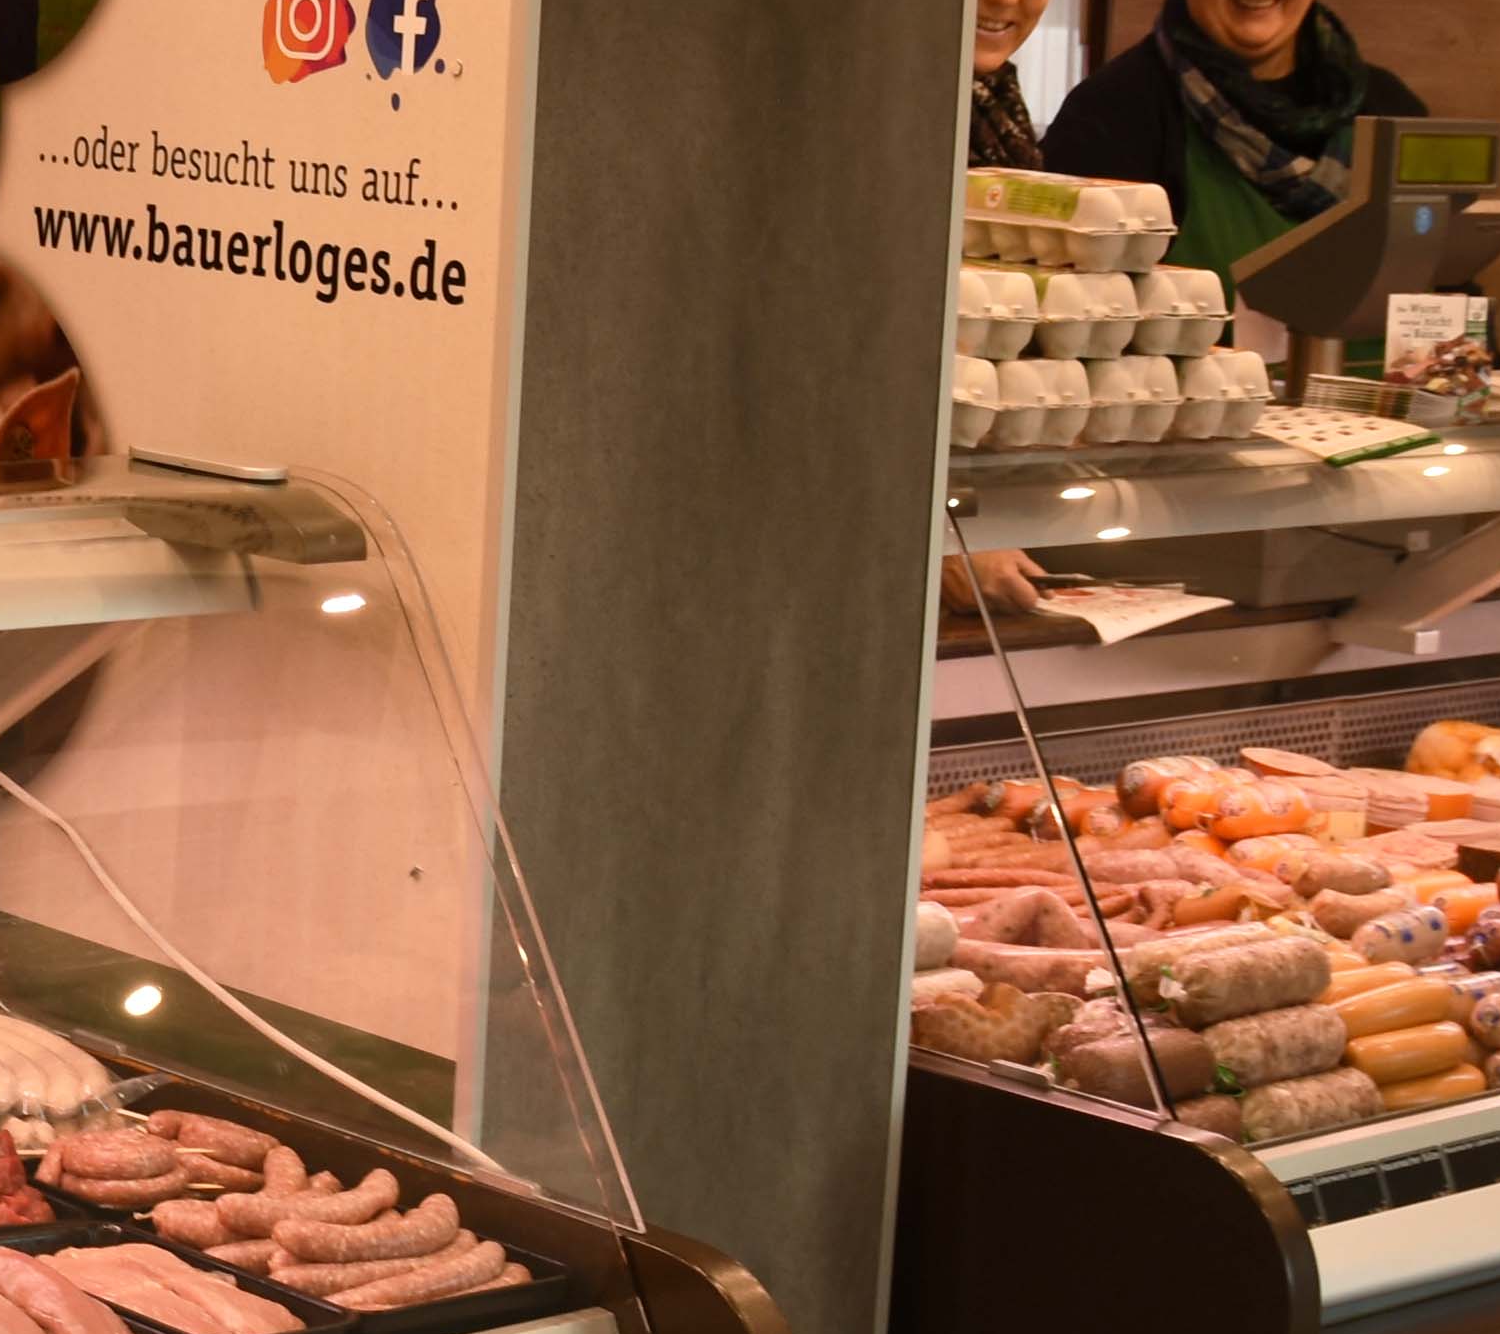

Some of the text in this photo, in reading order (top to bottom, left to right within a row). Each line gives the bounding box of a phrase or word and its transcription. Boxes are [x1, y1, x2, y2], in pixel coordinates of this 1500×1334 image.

[38, 125, 460, 211] ...oder besucht uns auf...
[34, 203, 467, 306] www.bauerloges.de
